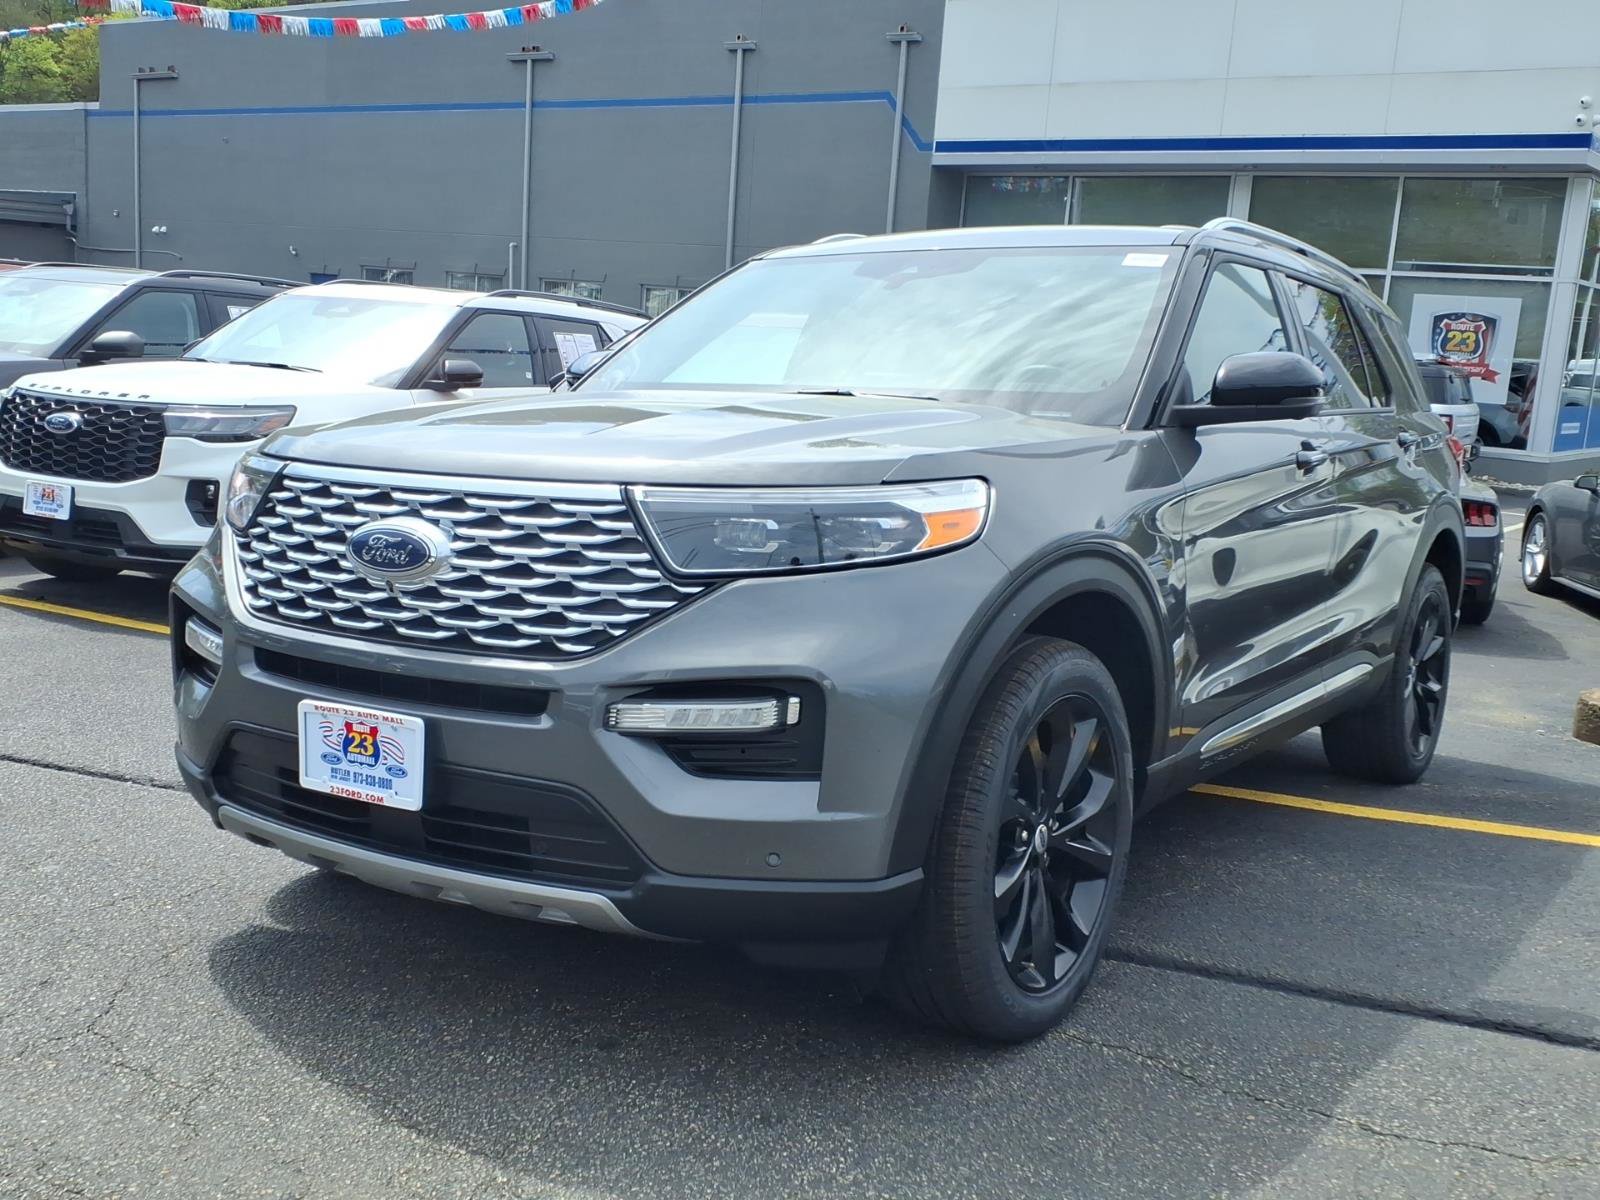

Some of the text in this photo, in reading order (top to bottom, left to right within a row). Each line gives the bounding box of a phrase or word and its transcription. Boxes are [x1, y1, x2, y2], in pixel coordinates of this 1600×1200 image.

[1451, 323, 1475, 331] ROUTE
[1446, 331, 1476, 352] 23
[29, 383, 150, 399] EXPLORER
[362, 534, 413, 565] Ford
[314, 705, 340, 714] ROUTE
[357, 711, 379, 720] AUTO
[382, 715, 404, 725] MALL
[348, 732, 375, 756] 23
[330, 785, 385, 804] 23FORD.COM
